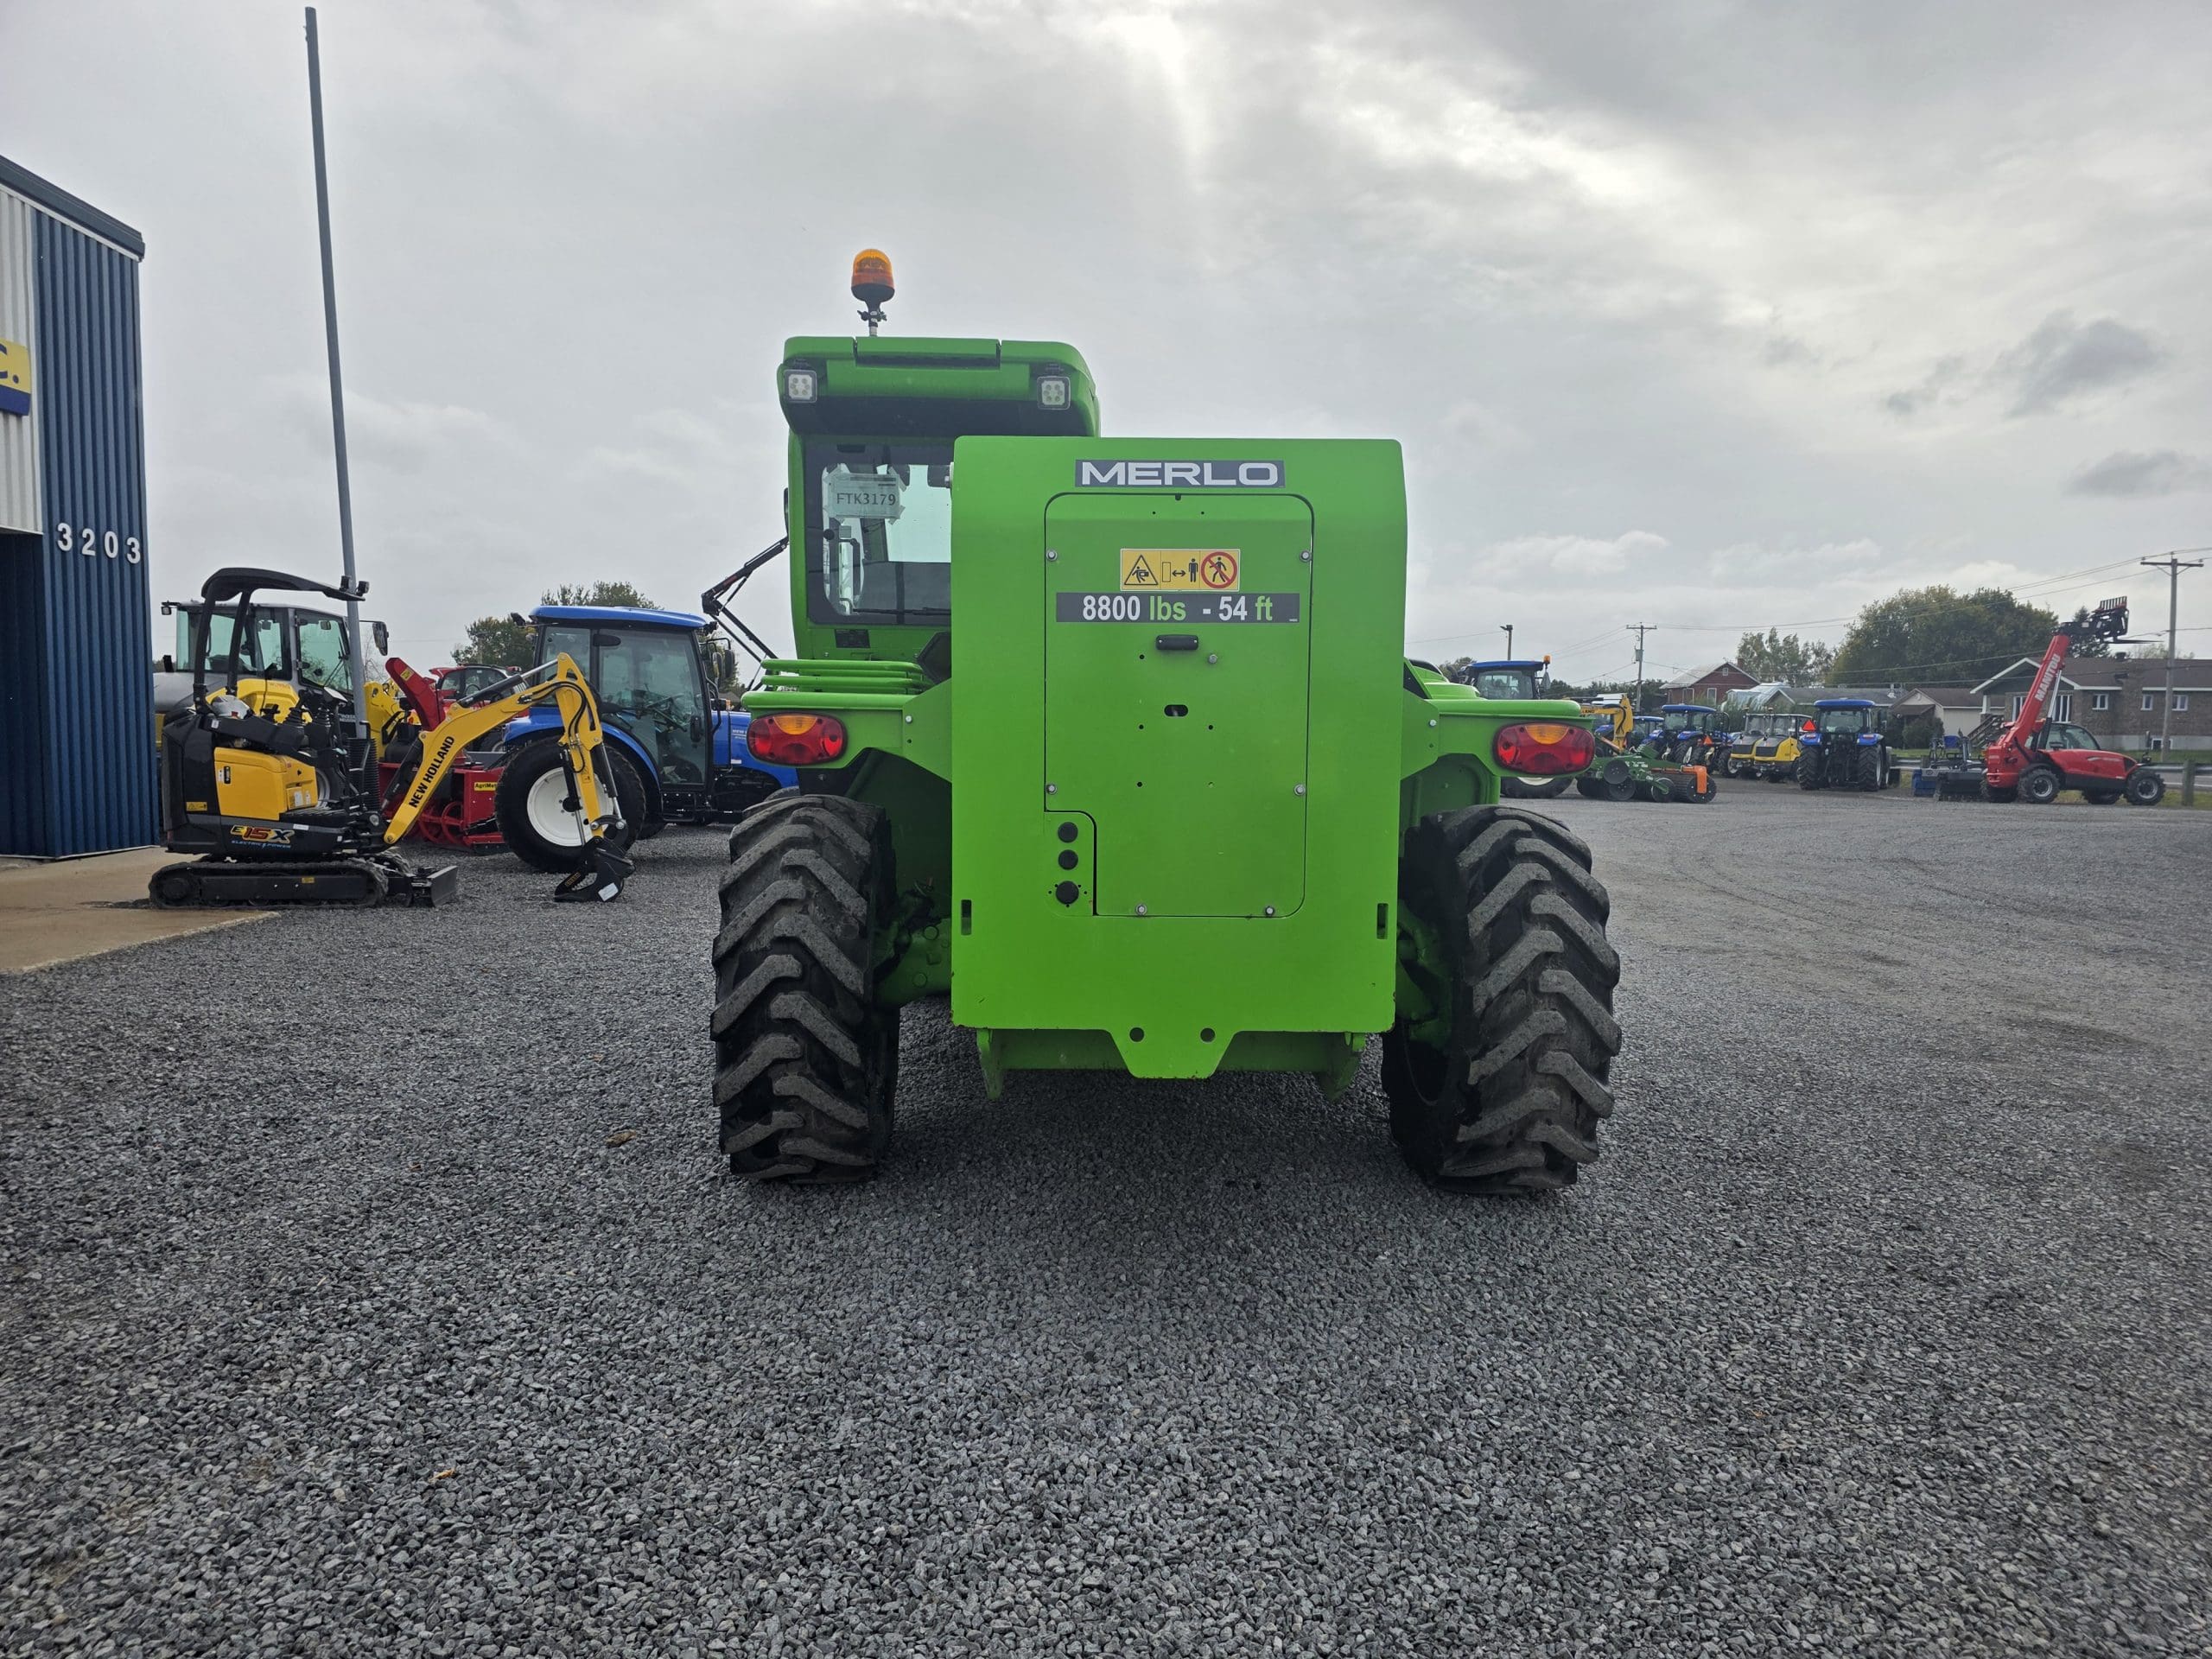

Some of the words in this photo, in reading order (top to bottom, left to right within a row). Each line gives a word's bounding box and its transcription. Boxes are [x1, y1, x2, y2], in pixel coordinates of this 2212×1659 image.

[1082, 461, 1279, 486] MERLO
[836, 493, 897, 506] FTK3179
[57, 523, 140, 563] 3203
[1083, 595, 1141, 621] 8800
[1149, 595, 1186, 621] lbs
[1218, 596, 1247, 620] 54
[1255, 596, 1273, 621] ft
[2035, 654, 2061, 701] MANITOU
[409, 782, 429, 809] NEW
[423, 735, 455, 785] HOLLAND
